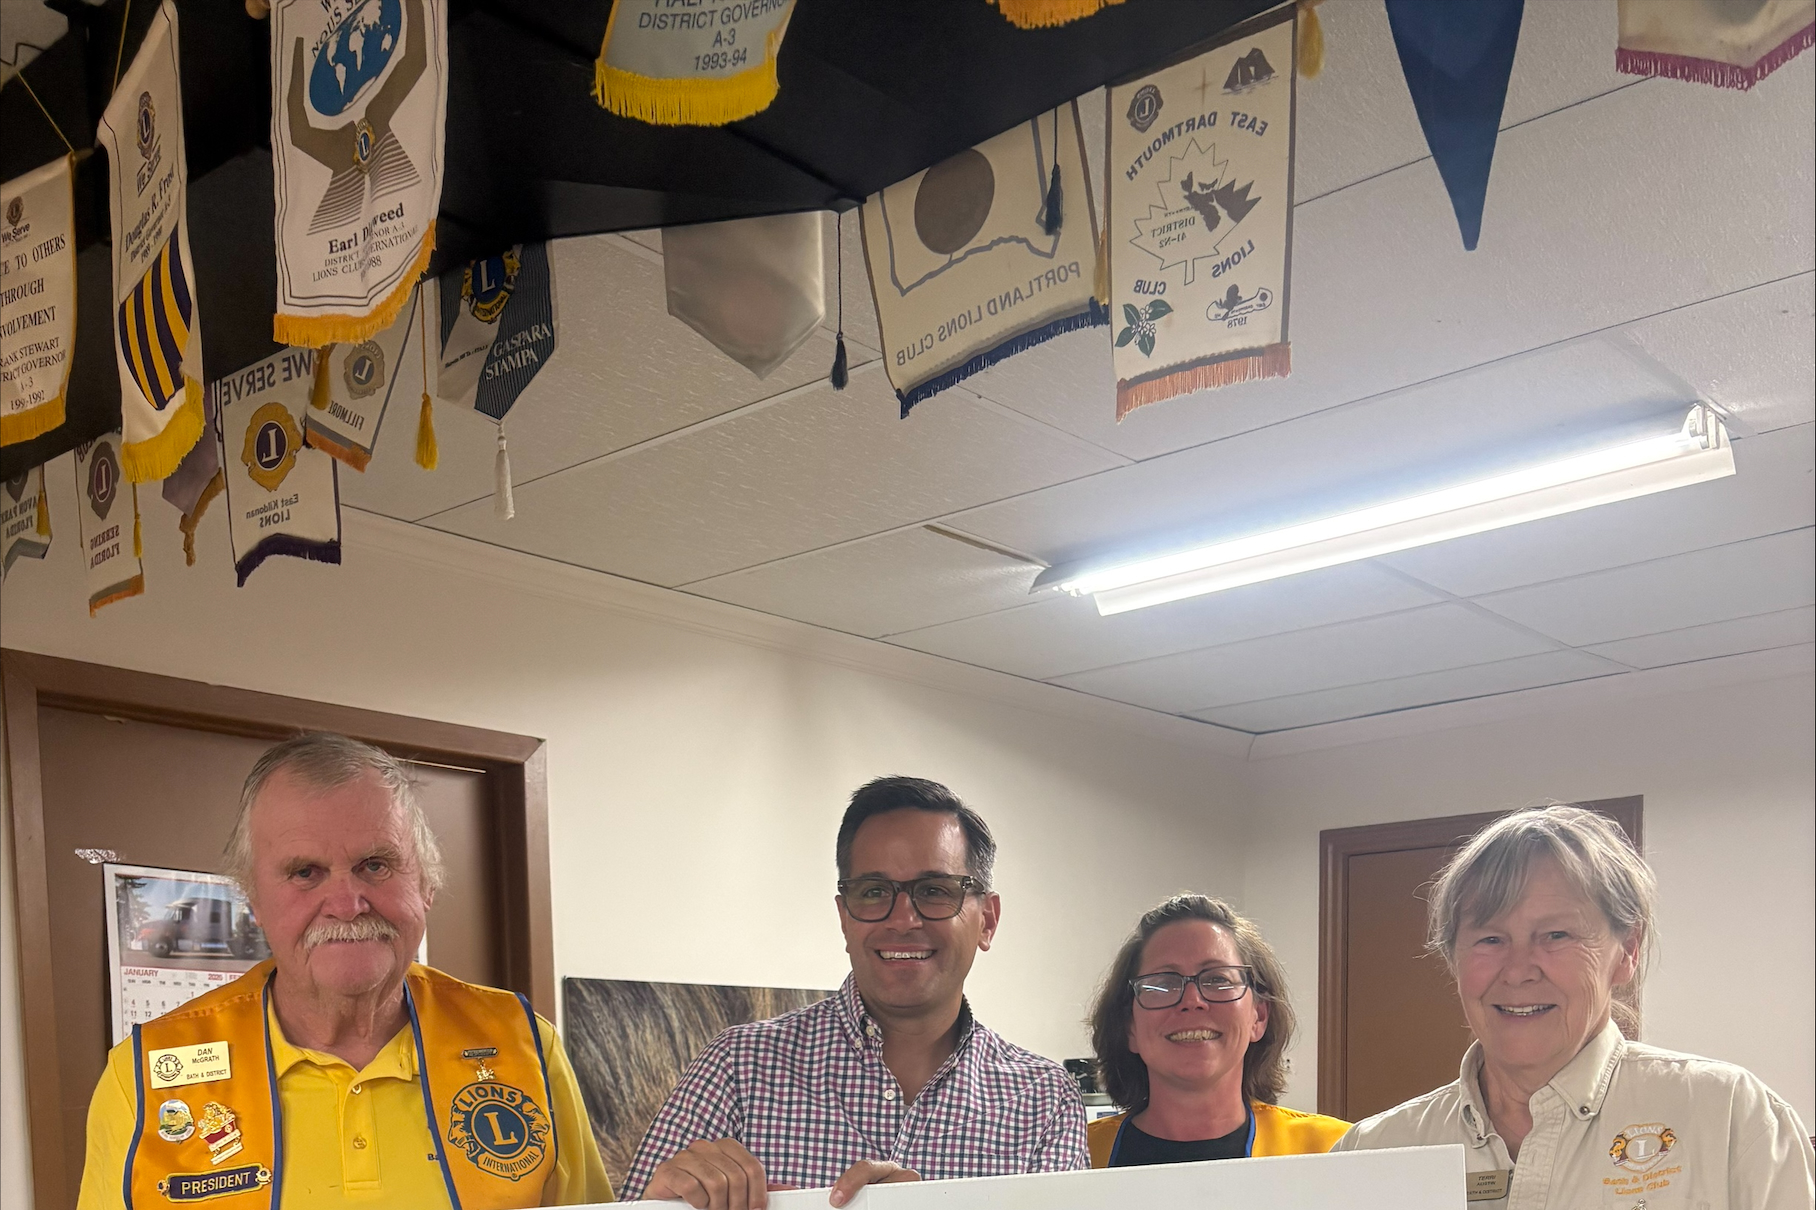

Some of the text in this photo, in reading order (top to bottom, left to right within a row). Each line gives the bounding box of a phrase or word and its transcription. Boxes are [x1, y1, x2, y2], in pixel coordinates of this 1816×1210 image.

[639, 10, 718, 30] DISTRICT
[713, 28, 737, 48] A-3
[694, 48, 748, 71] 1993-94
[15, 253, 28, 270] TO
[32, 233, 66, 262] OTHERS
[328, 232, 359, 255] Earl
[312, 268, 338, 282] LIONS
[480, 260, 496, 293] L
[19, 337, 60, 359] STEWART
[493, 323, 552, 357] GASPARA
[485, 347, 539, 380] STAMPA
[123, 968, 159, 978] JANUARY
[144, 1010, 152, 1018] 12
[191, 1055, 220, 1064] McGRATH
[197, 1047, 213, 1056] DAN
[164, 1062, 173, 1073] L
[206, 1069, 227, 1077] DISTRICT
[458, 1085, 518, 1109] LIONS
[483, 1111, 519, 1146] L
[1626, 1126, 1663, 1138] LIONS
[1635, 1139, 1656, 1160] L
[482, 1150, 540, 1173] INTERNATIONAL
[181, 1171, 251, 1196] PRESIDENT
[1642, 1165, 1682, 1182] District
[1646, 1179, 1670, 1191] Club
